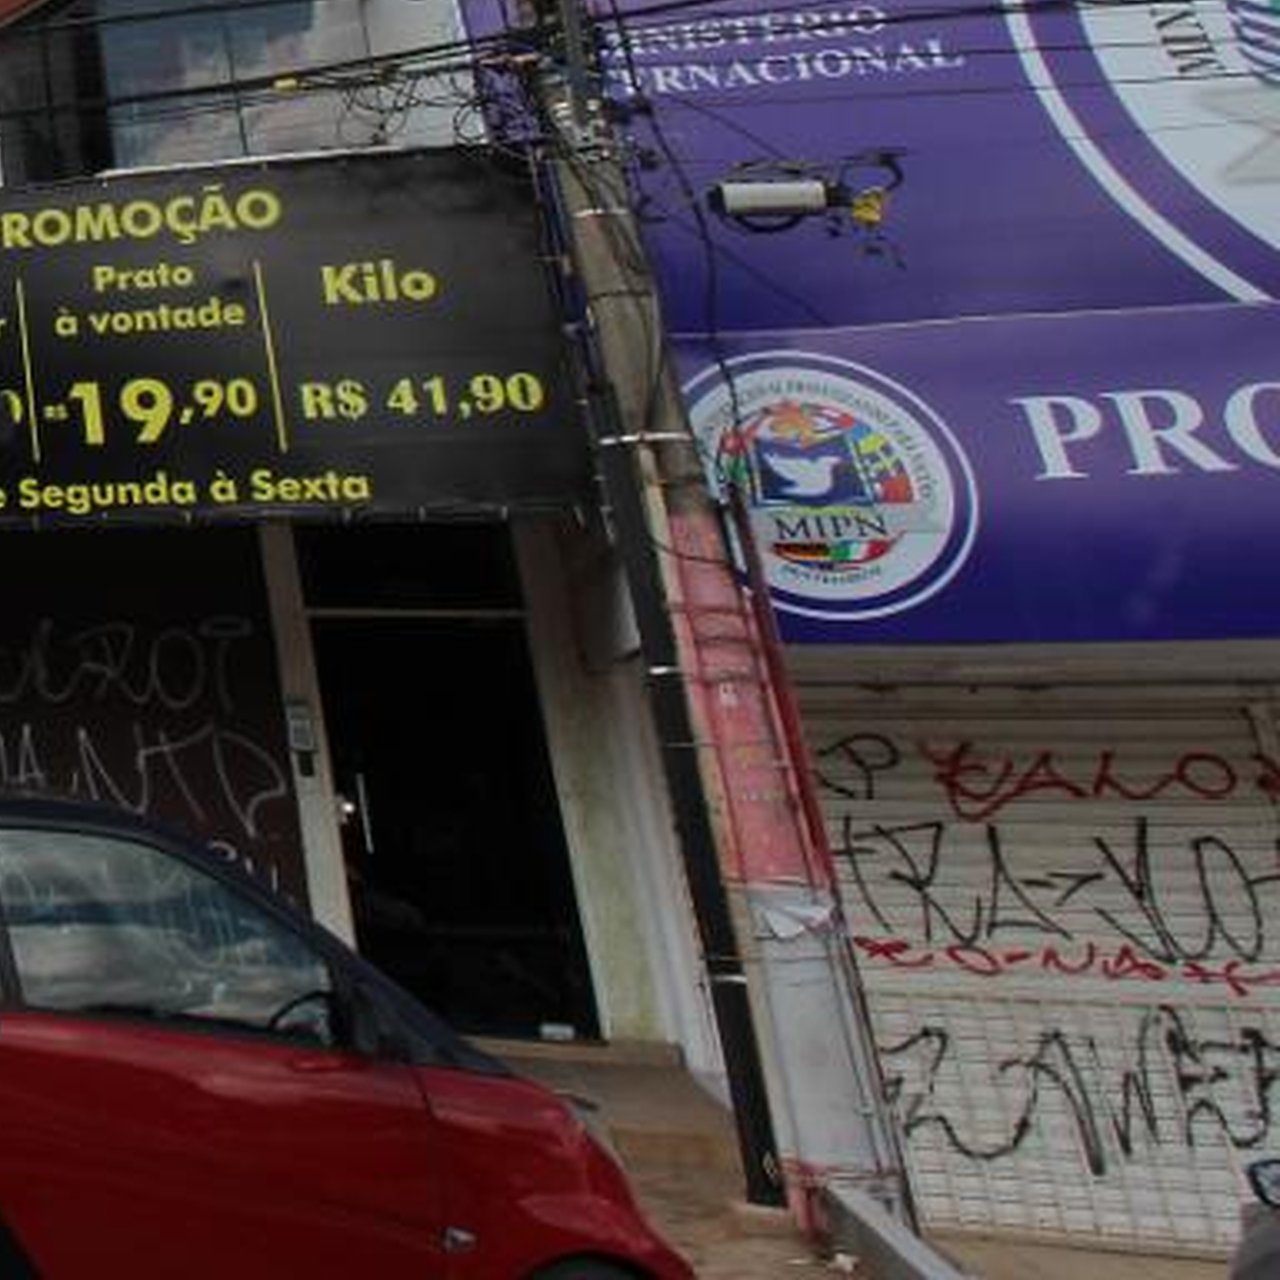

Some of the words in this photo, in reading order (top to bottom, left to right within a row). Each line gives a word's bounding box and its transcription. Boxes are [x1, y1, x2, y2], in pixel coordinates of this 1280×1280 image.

[93, 264, 194, 292] Prato
[322, 261, 436, 304] Kilo
[55, 305, 79, 337] à
[91, 300, 246, 334] vontade
[69, 377, 258, 446] 19,90
[300, 381, 365, 422] R$
[385, 372, 543, 419] 41,90
[18, 474, 197, 516] Segunda
[209, 470, 238, 503] à
[250, 470, 371, 504] Sexta
[774, 516, 888, 540] MIPN
